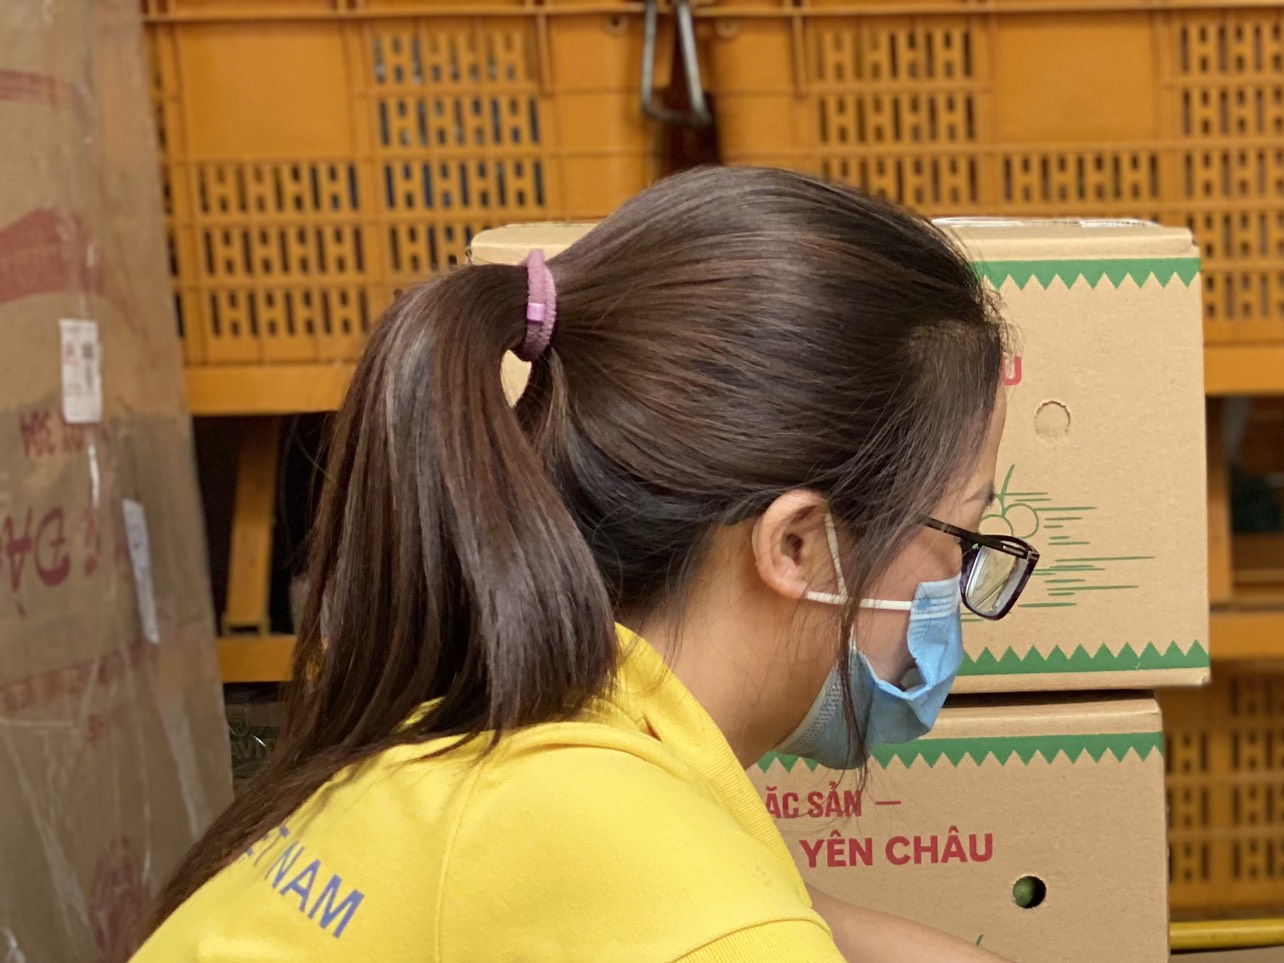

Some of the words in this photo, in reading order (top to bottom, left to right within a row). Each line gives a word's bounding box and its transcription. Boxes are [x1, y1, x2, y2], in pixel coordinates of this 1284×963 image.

[807, 781, 862, 818] SẢN
[799, 829, 873, 868] YÊN
[885, 825, 994, 865] CHÂU
